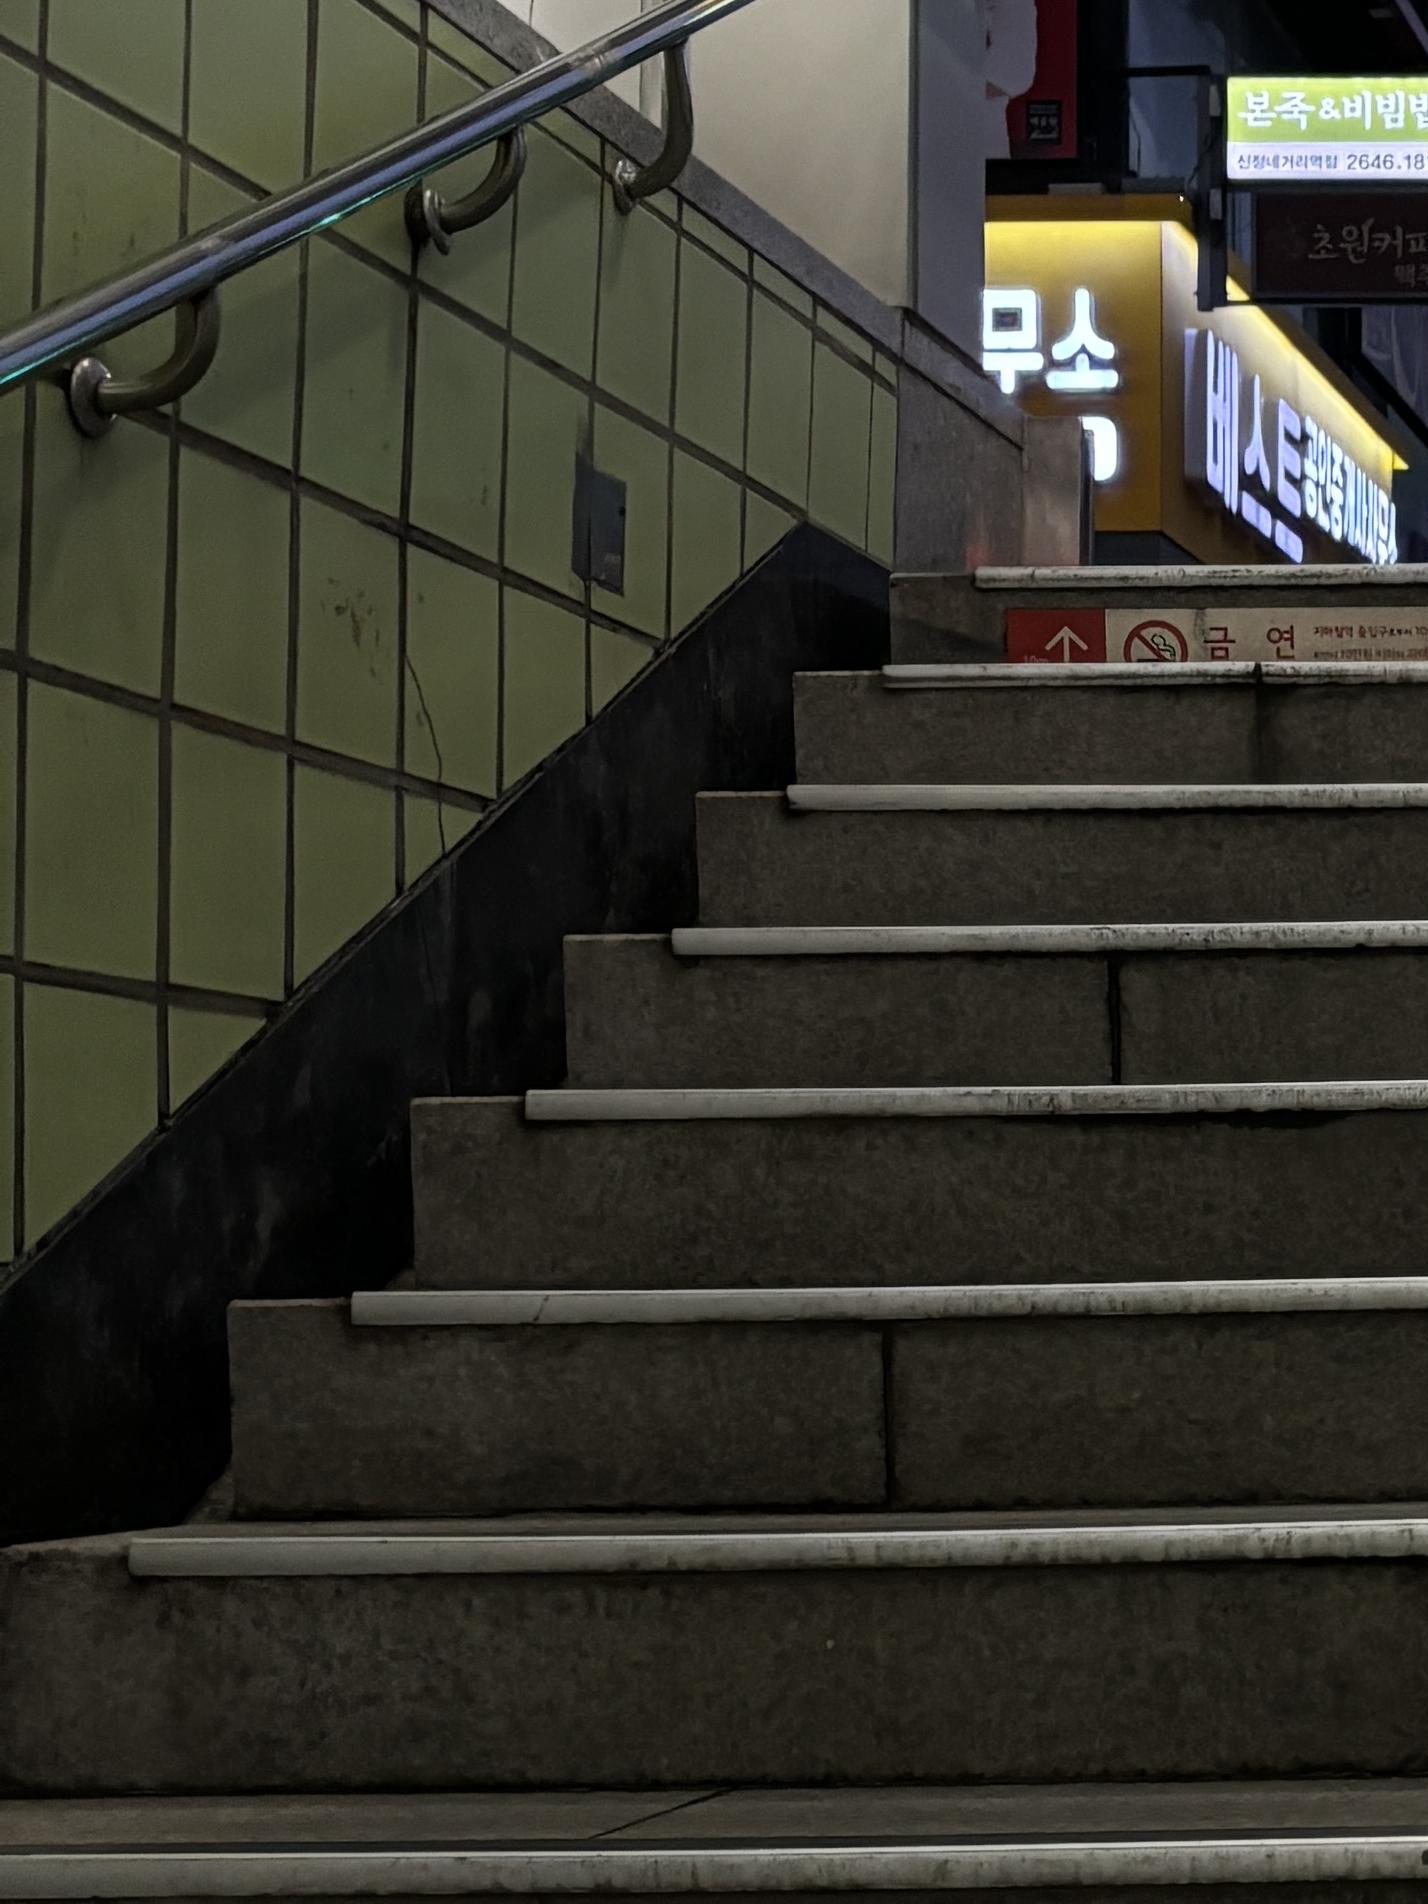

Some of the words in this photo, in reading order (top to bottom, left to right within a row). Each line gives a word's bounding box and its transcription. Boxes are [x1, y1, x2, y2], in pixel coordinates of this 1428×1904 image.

[1206, 328, 1304, 564] 베스트
[1204, 627, 1236, 660] 금
[1266, 625, 1295, 660] 연
